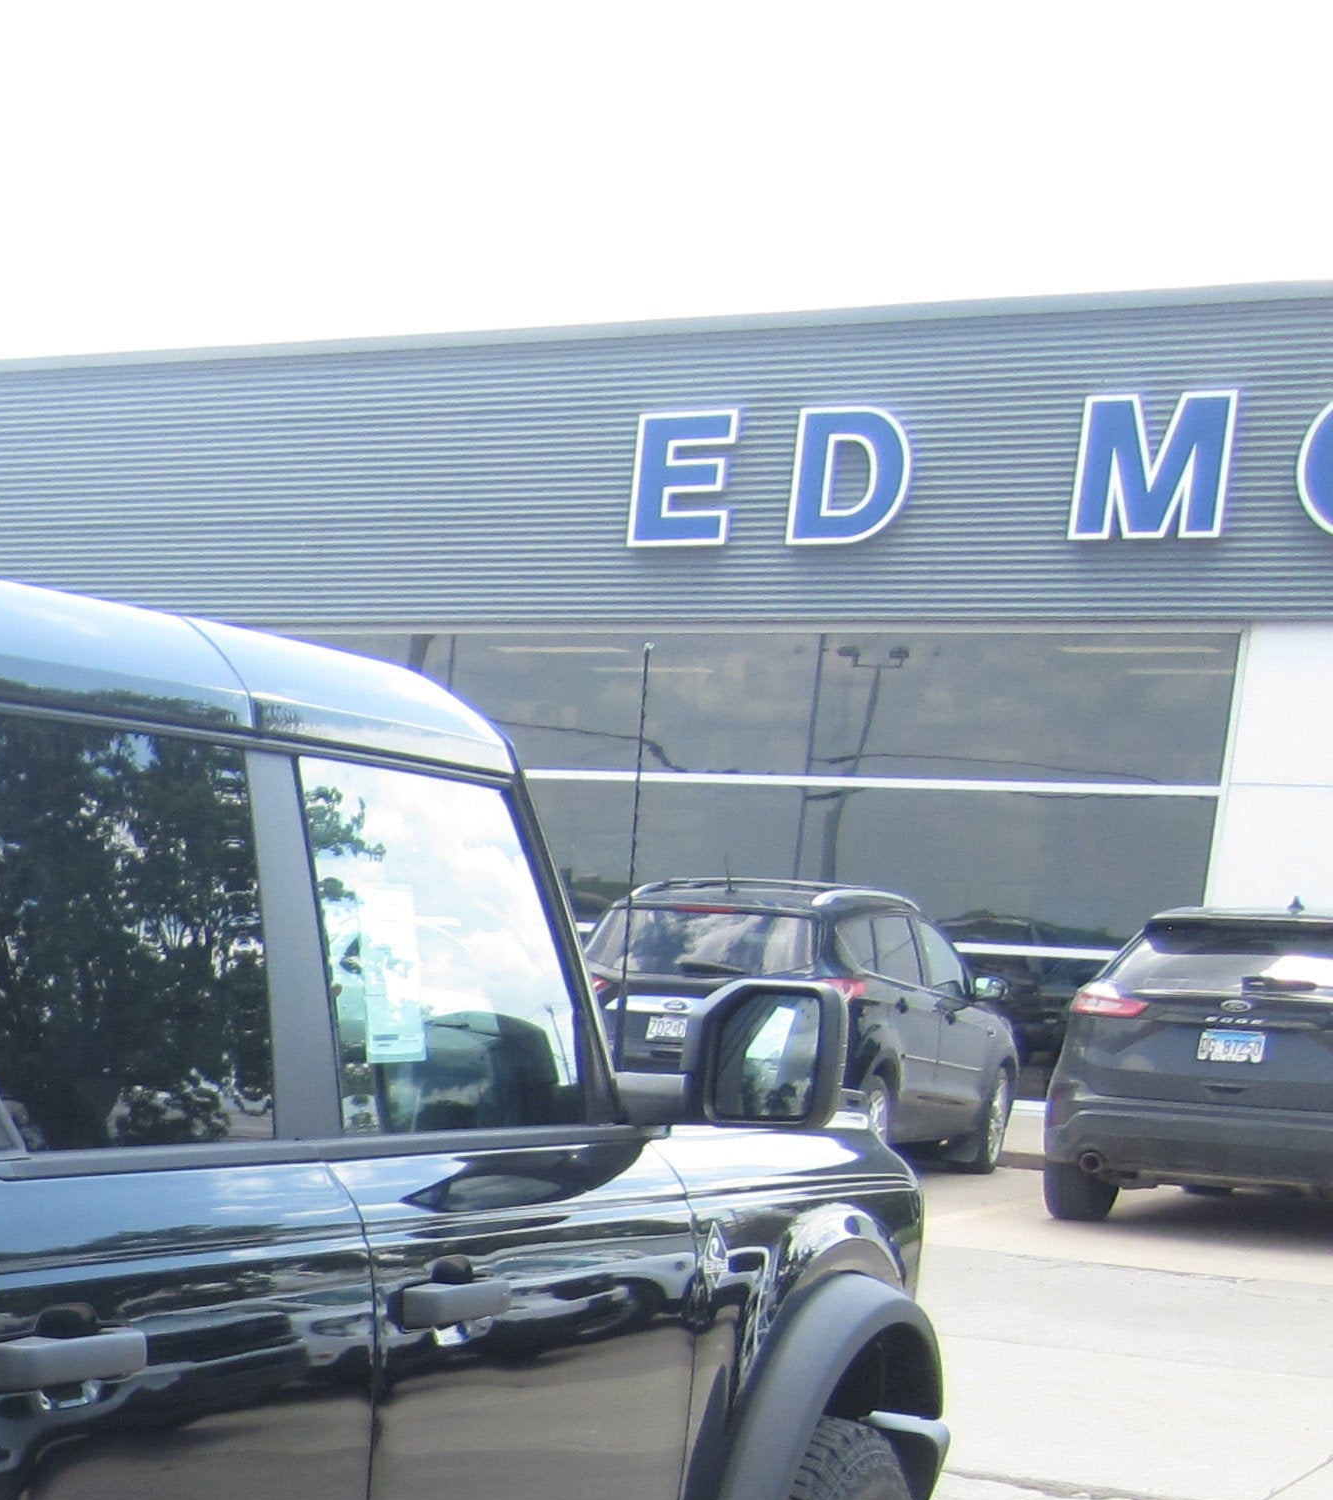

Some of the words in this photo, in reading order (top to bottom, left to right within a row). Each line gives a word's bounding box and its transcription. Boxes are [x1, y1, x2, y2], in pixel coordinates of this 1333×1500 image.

[626, 405, 913, 547] ED
[1067, 389, 1333, 541] M
[1204, 1015, 1264, 1025] EDGE
